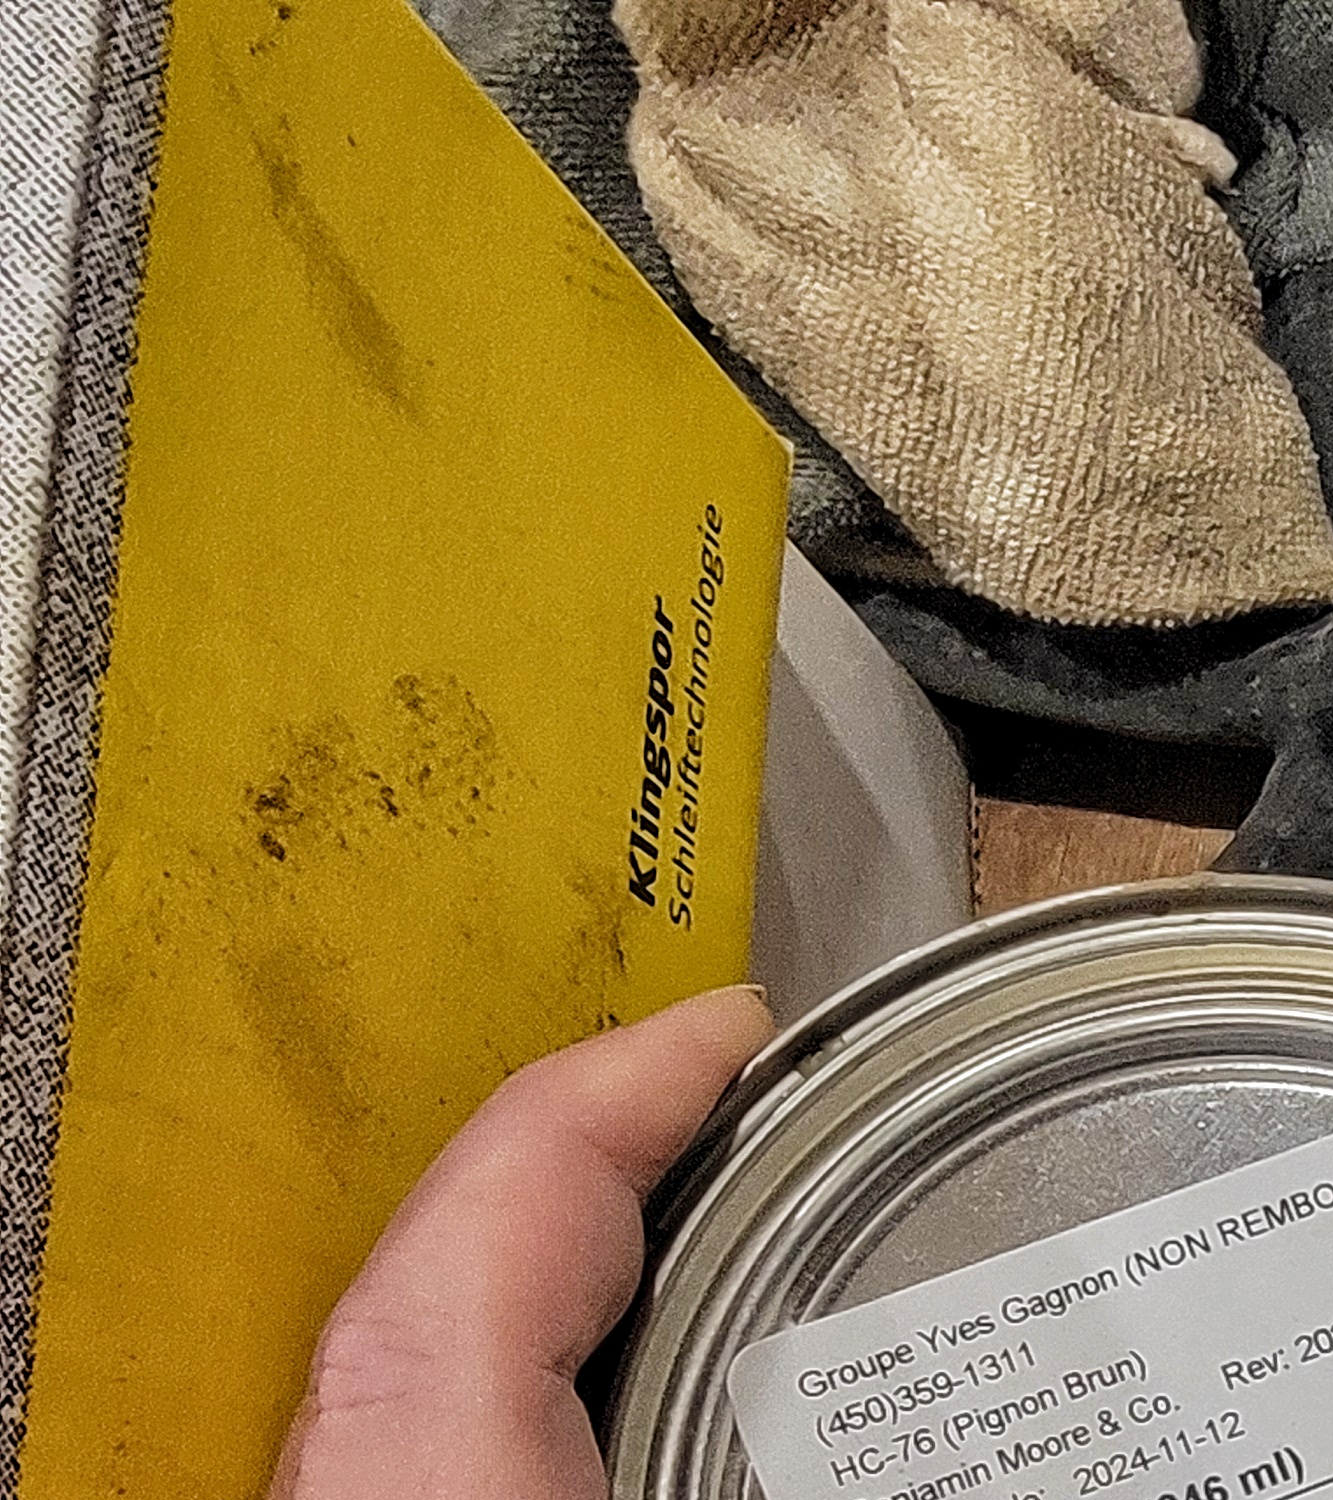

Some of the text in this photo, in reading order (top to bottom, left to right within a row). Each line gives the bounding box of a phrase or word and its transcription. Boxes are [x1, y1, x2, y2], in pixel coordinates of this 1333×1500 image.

[628, 594, 675, 907] Klingspor
[668, 503, 724, 933] Schleiftechnologie
[798, 1343, 915, 1397] Groupe
[916, 1315, 996, 1354] Yves
[1001, 1269, 1119, 1324] Gagnon
[1125, 1228, 1212, 1287] (NON
[816, 1341, 1035, 1448] (450)359-1311
[830, 1350, 1146, 1487] HC-76 (Pignon Brun)
[1220, 1348, 1290, 1391] Rev:
[995, 1425, 1092, 1475] Moore
[1097, 1410, 1123, 1436] &
[1128, 1395, 1181, 1424] Co.
[1072, 1411, 1246, 1496] 2024-11-12
[1237, 1446, 1304, 1496] ml)
